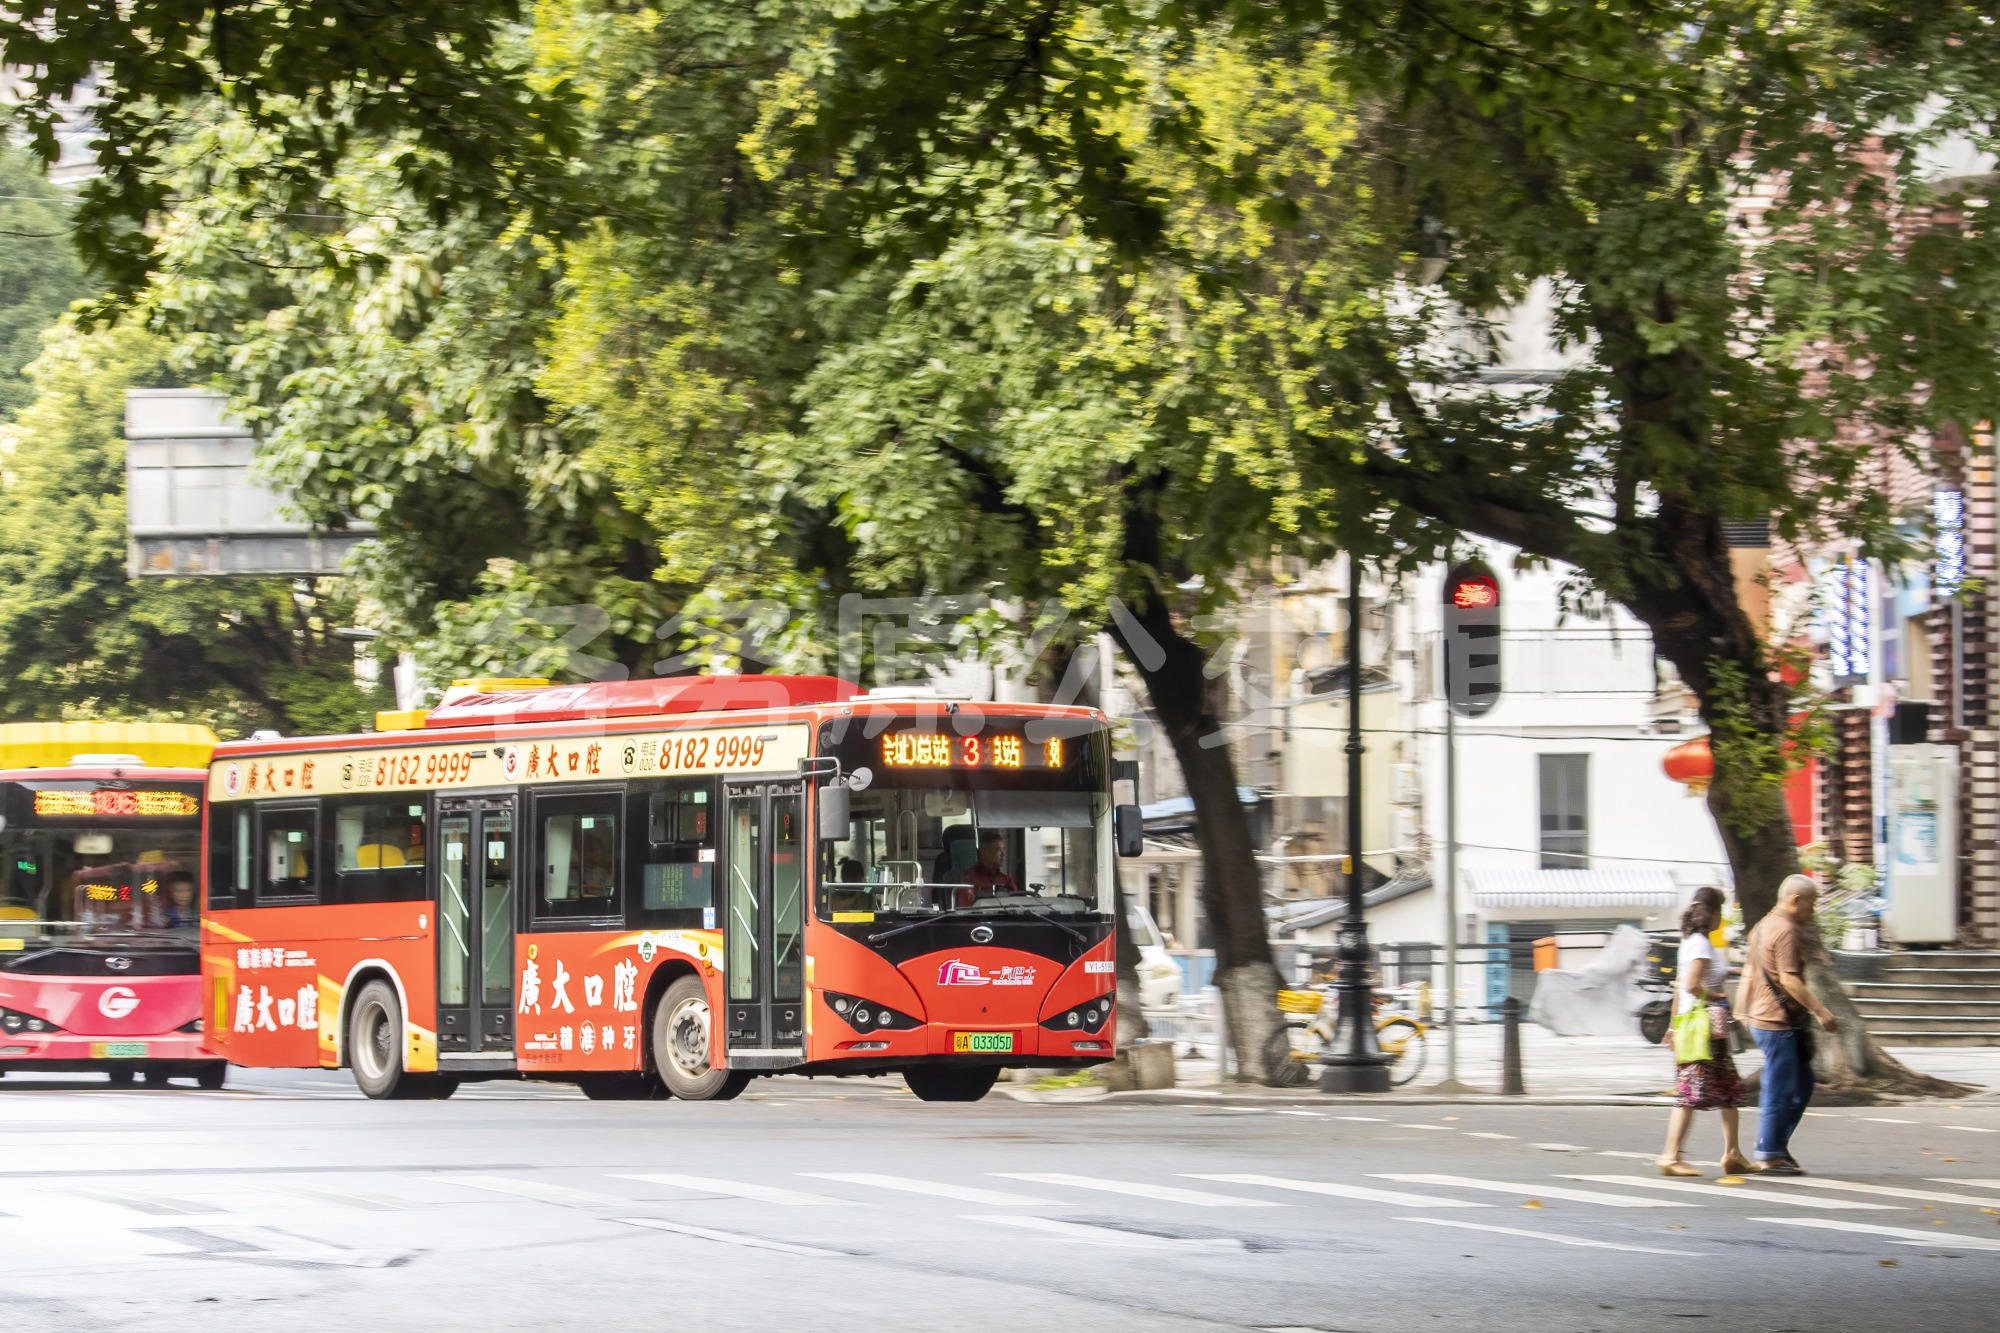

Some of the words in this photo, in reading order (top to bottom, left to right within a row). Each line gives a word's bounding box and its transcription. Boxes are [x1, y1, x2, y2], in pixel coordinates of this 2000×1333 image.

[525, 741, 602, 779] 廣大口腔
[659, 737, 709, 769] 8182
[714, 735, 765, 767] 9999
[962, 736, 981, 766] 3
[375, 754, 420, 787] 8182
[425, 752, 471, 785] 9999
[518, 958, 638, 1016] 廣大口腔
[989, 966, 1036, 980] 一汽巴士
[560, 1025, 636, 1050] 精准种牙
